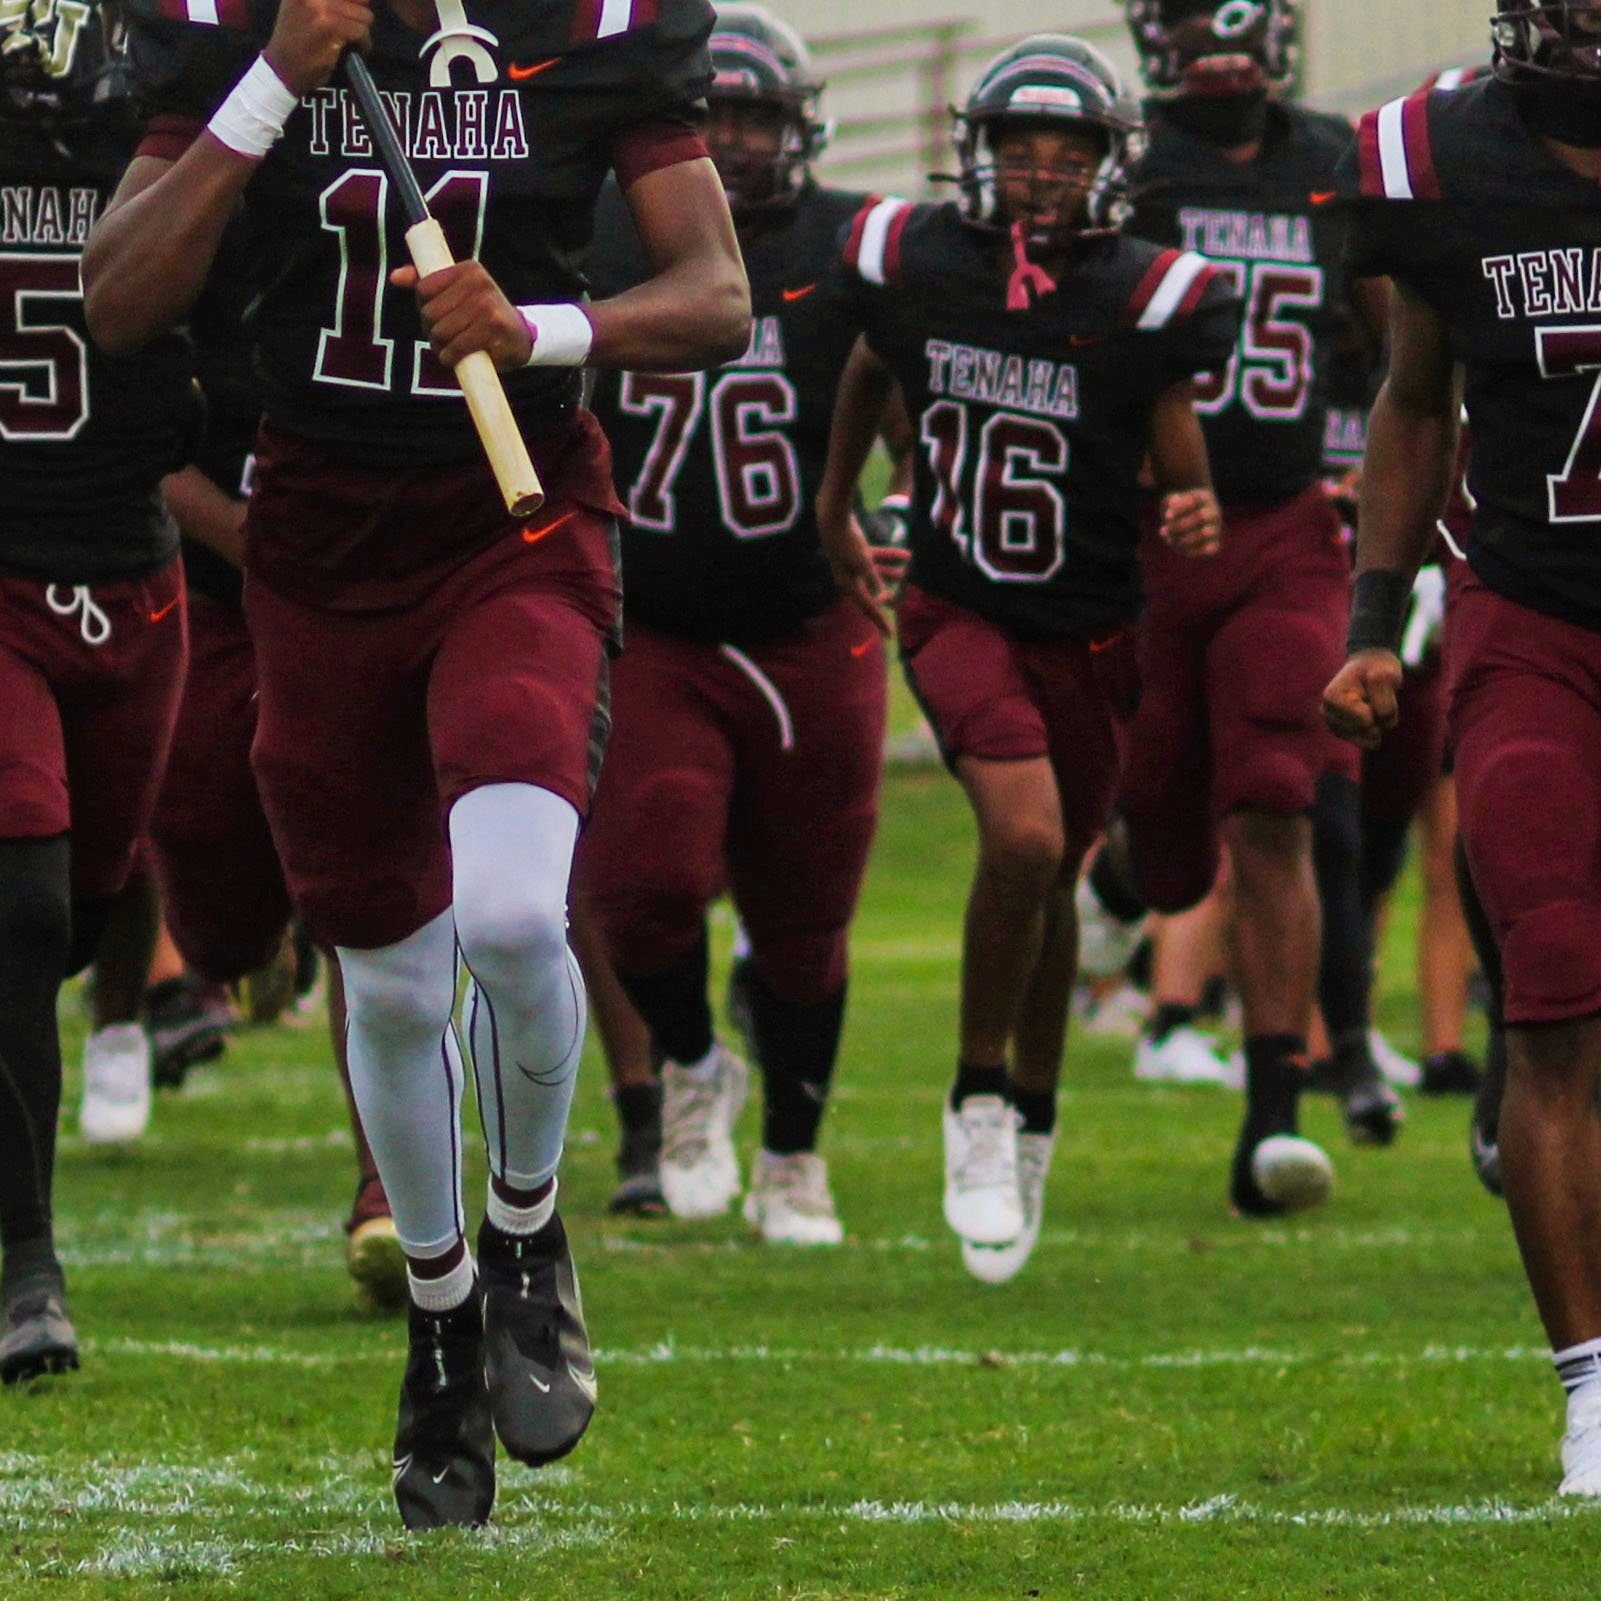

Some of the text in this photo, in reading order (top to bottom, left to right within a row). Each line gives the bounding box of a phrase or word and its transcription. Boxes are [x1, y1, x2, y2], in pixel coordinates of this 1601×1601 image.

[620, 369, 801, 538] 76
[925, 338, 1079, 419] TENAHA
[920, 399, 1069, 584] 16
